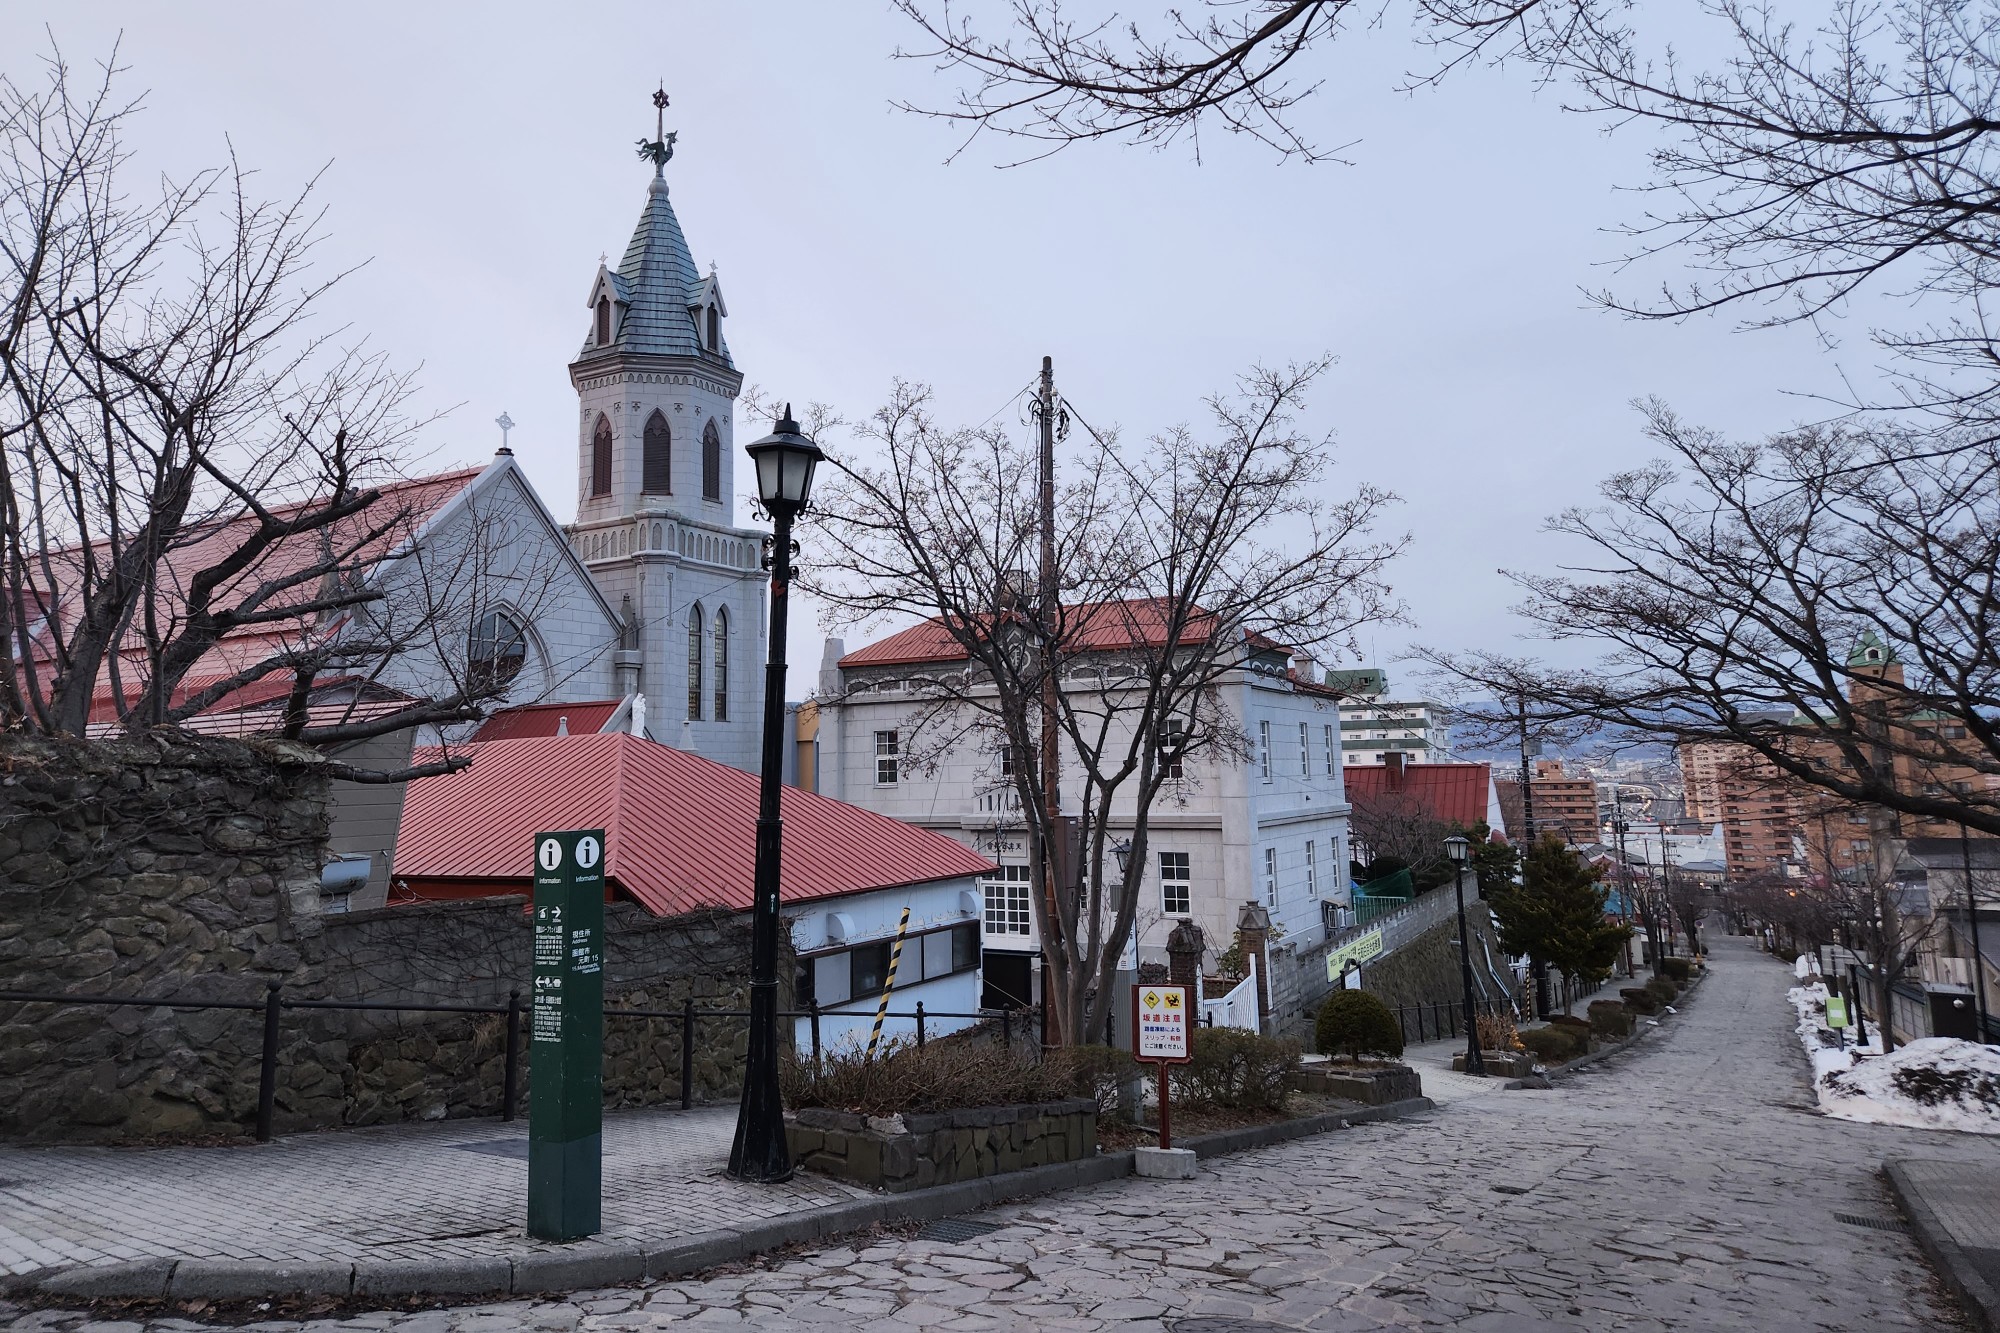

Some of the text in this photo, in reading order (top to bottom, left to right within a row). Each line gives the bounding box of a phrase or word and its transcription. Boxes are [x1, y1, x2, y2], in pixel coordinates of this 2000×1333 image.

[575, 874, 599, 883] Information
[578, 954, 599, 965] 元町 15
[1143, 1013, 1181, 1023] 坂道注意
